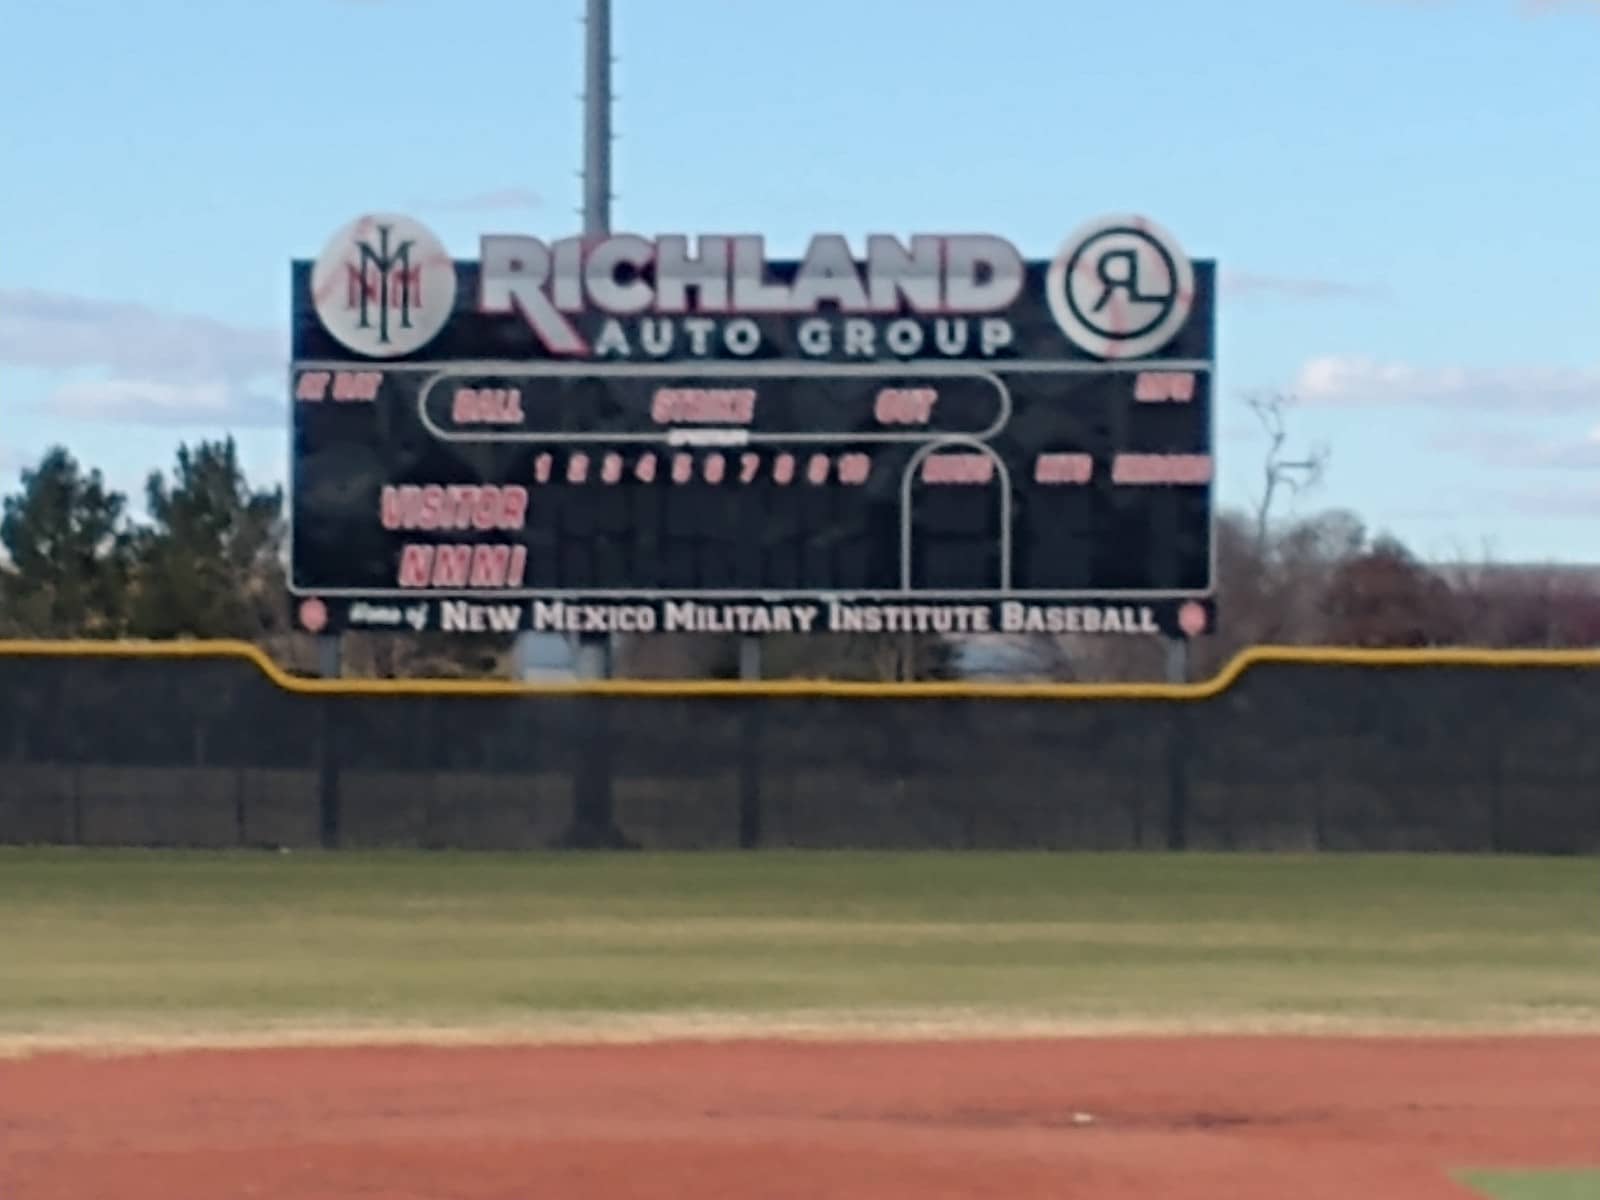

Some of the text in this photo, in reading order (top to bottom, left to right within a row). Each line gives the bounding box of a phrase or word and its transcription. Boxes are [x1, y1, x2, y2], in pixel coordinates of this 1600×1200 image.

[480, 233, 1024, 357] RICHLAND
[594, 318, 1014, 357] AUTO GROUP
